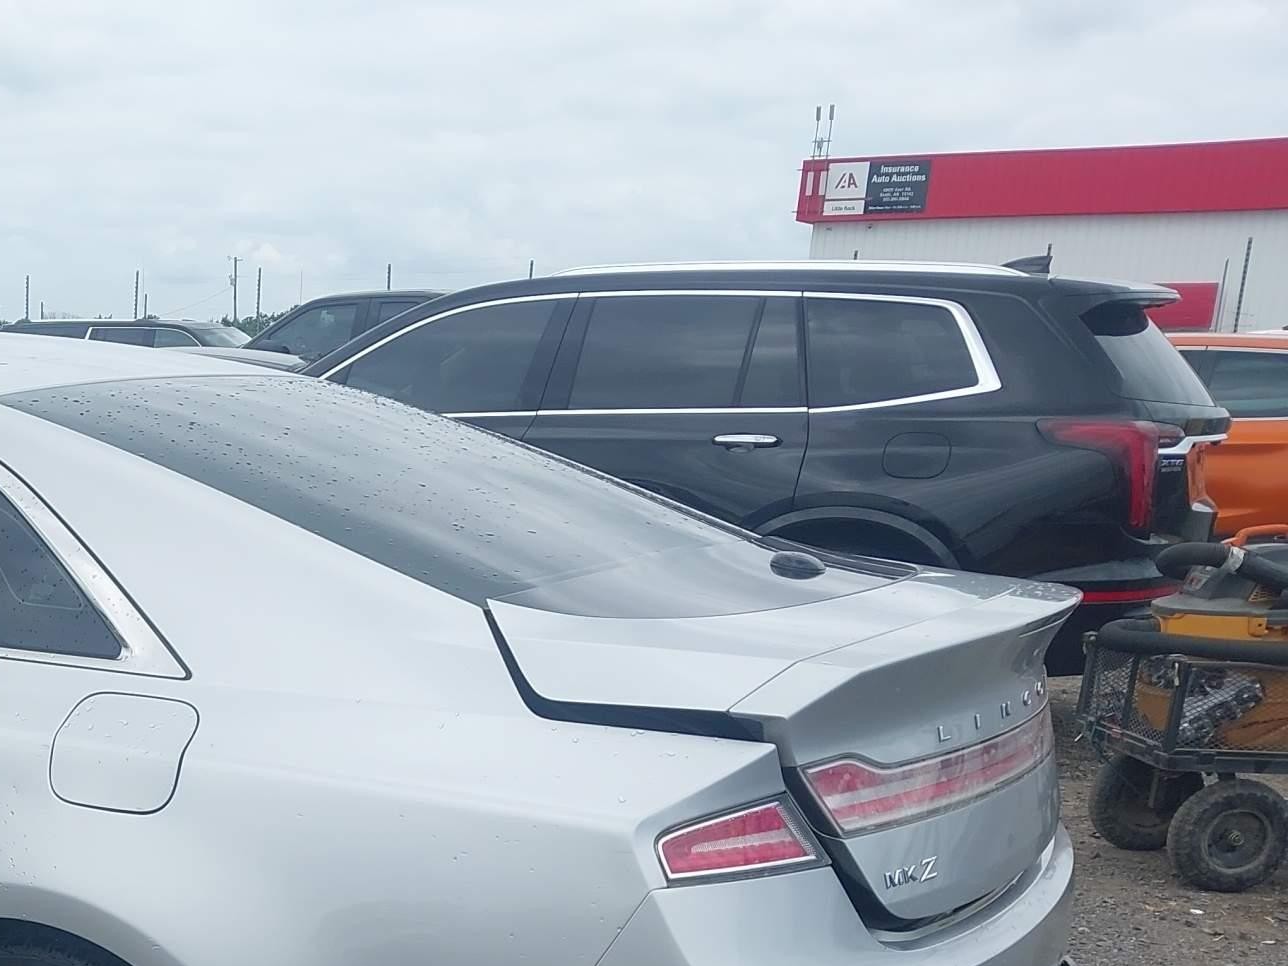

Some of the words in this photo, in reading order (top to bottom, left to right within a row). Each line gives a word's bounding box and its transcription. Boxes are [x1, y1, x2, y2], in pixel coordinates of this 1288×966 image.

[881, 165, 920, 173] Insurance
[872, 174, 890, 183] Auto
[892, 173, 927, 182] Auctions
[883, 856, 938, 890] MKZ
